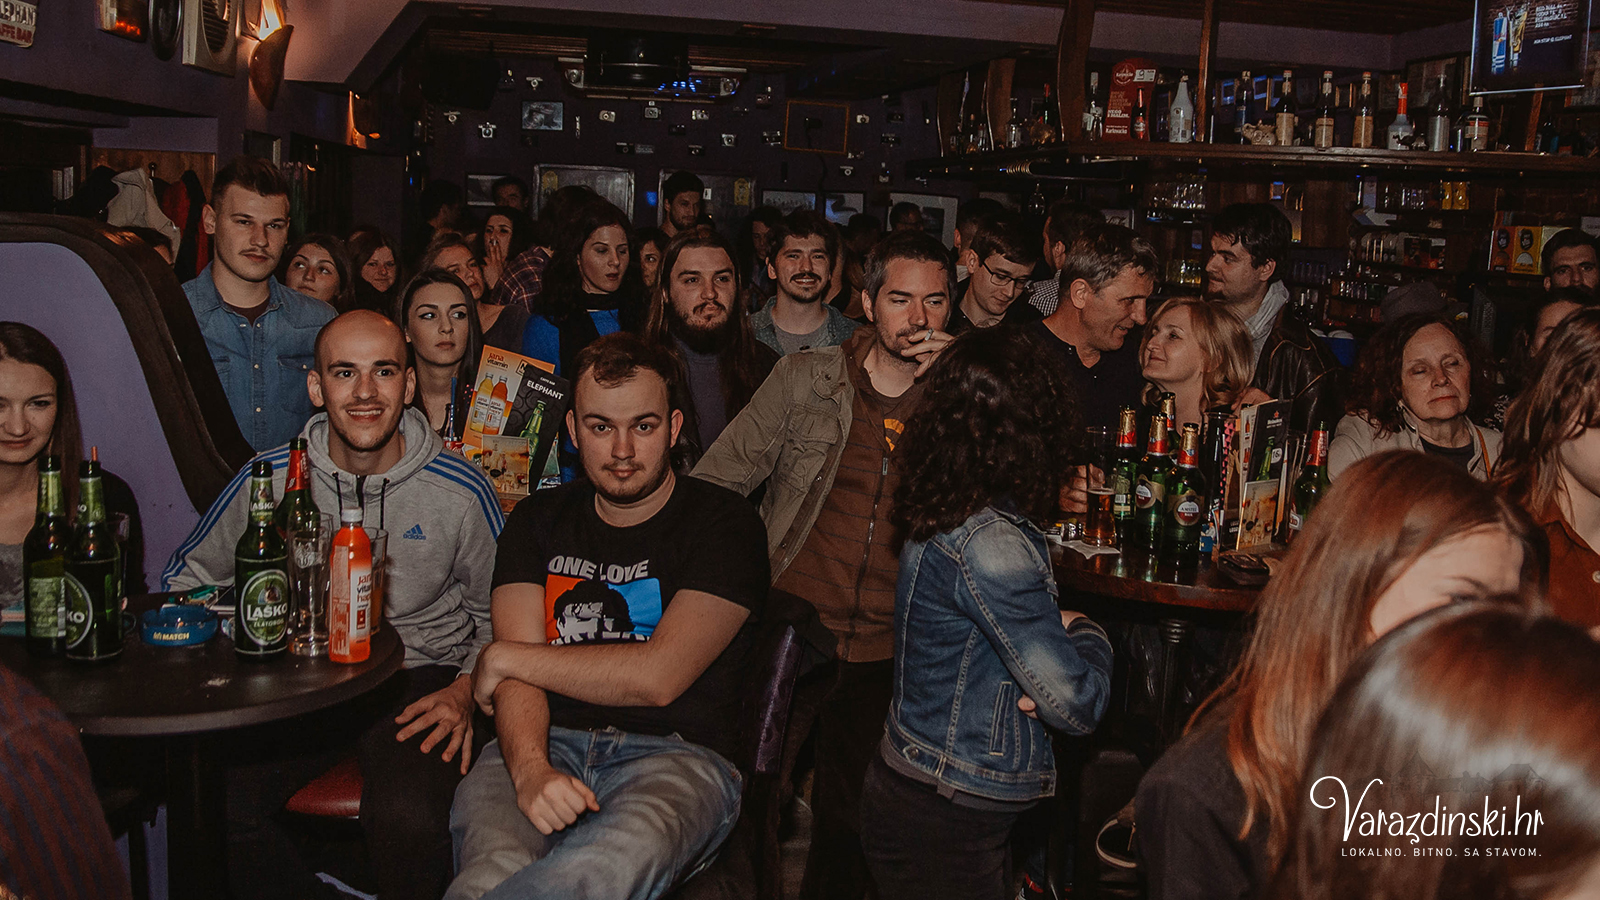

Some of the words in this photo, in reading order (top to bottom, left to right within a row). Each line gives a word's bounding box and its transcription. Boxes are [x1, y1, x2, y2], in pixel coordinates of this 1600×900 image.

[487, 358, 509, 369] vitamin
[526, 379, 564, 400] ELEPHANT
[548, 555, 597, 580] ONE
[599, 558, 650, 584] LOVE
[246, 602, 288, 621] LAŠKO
[162, 632, 190, 641] MATCH
